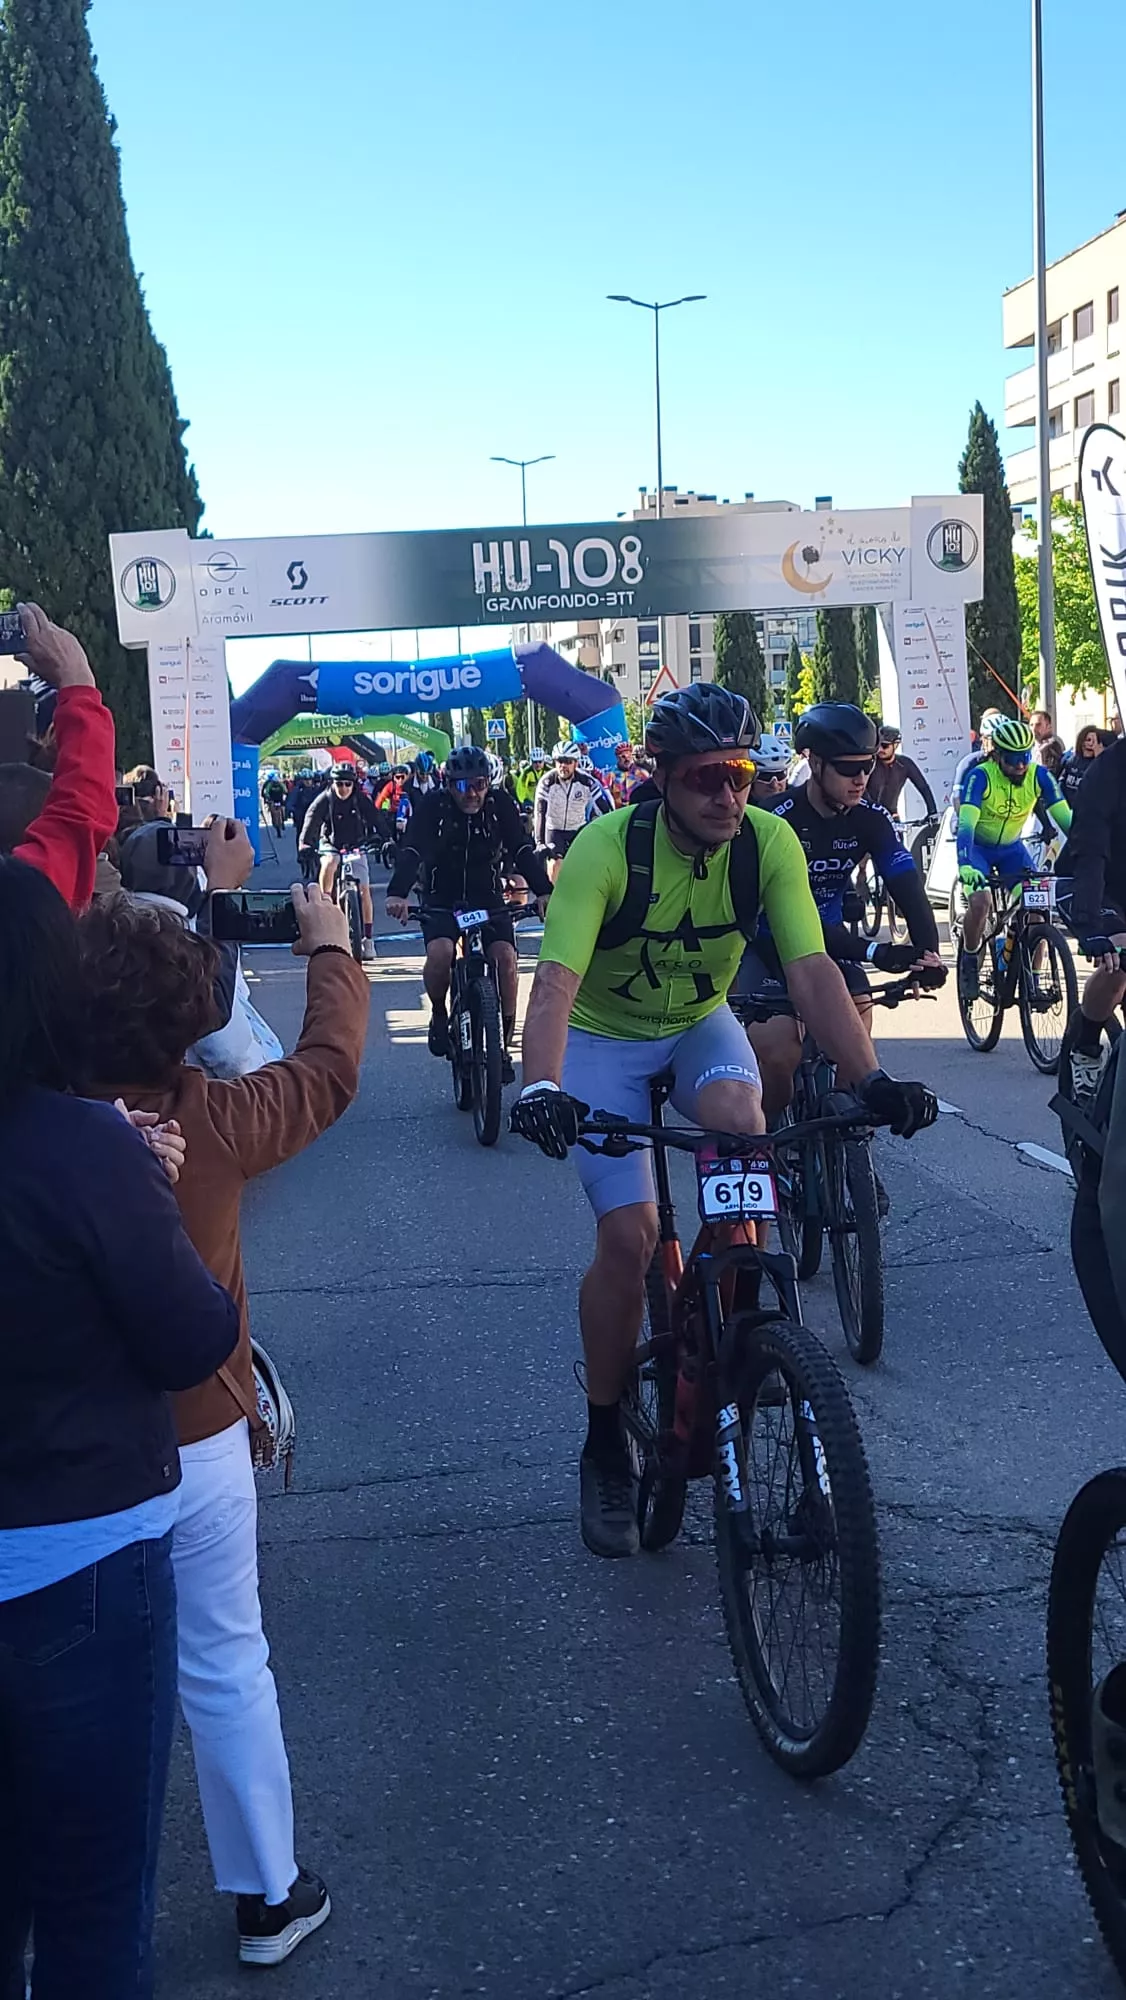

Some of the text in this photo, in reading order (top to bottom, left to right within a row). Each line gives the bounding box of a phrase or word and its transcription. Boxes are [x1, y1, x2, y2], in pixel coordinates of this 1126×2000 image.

[473, 535, 643, 594] HU-108
[199, 586, 249, 597] OPEL
[269, 595, 329, 607] SCOTT
[1028, 894, 1046, 904] 623
[462, 911, 482, 923] 641
[715, 1181, 763, 1204] 619
